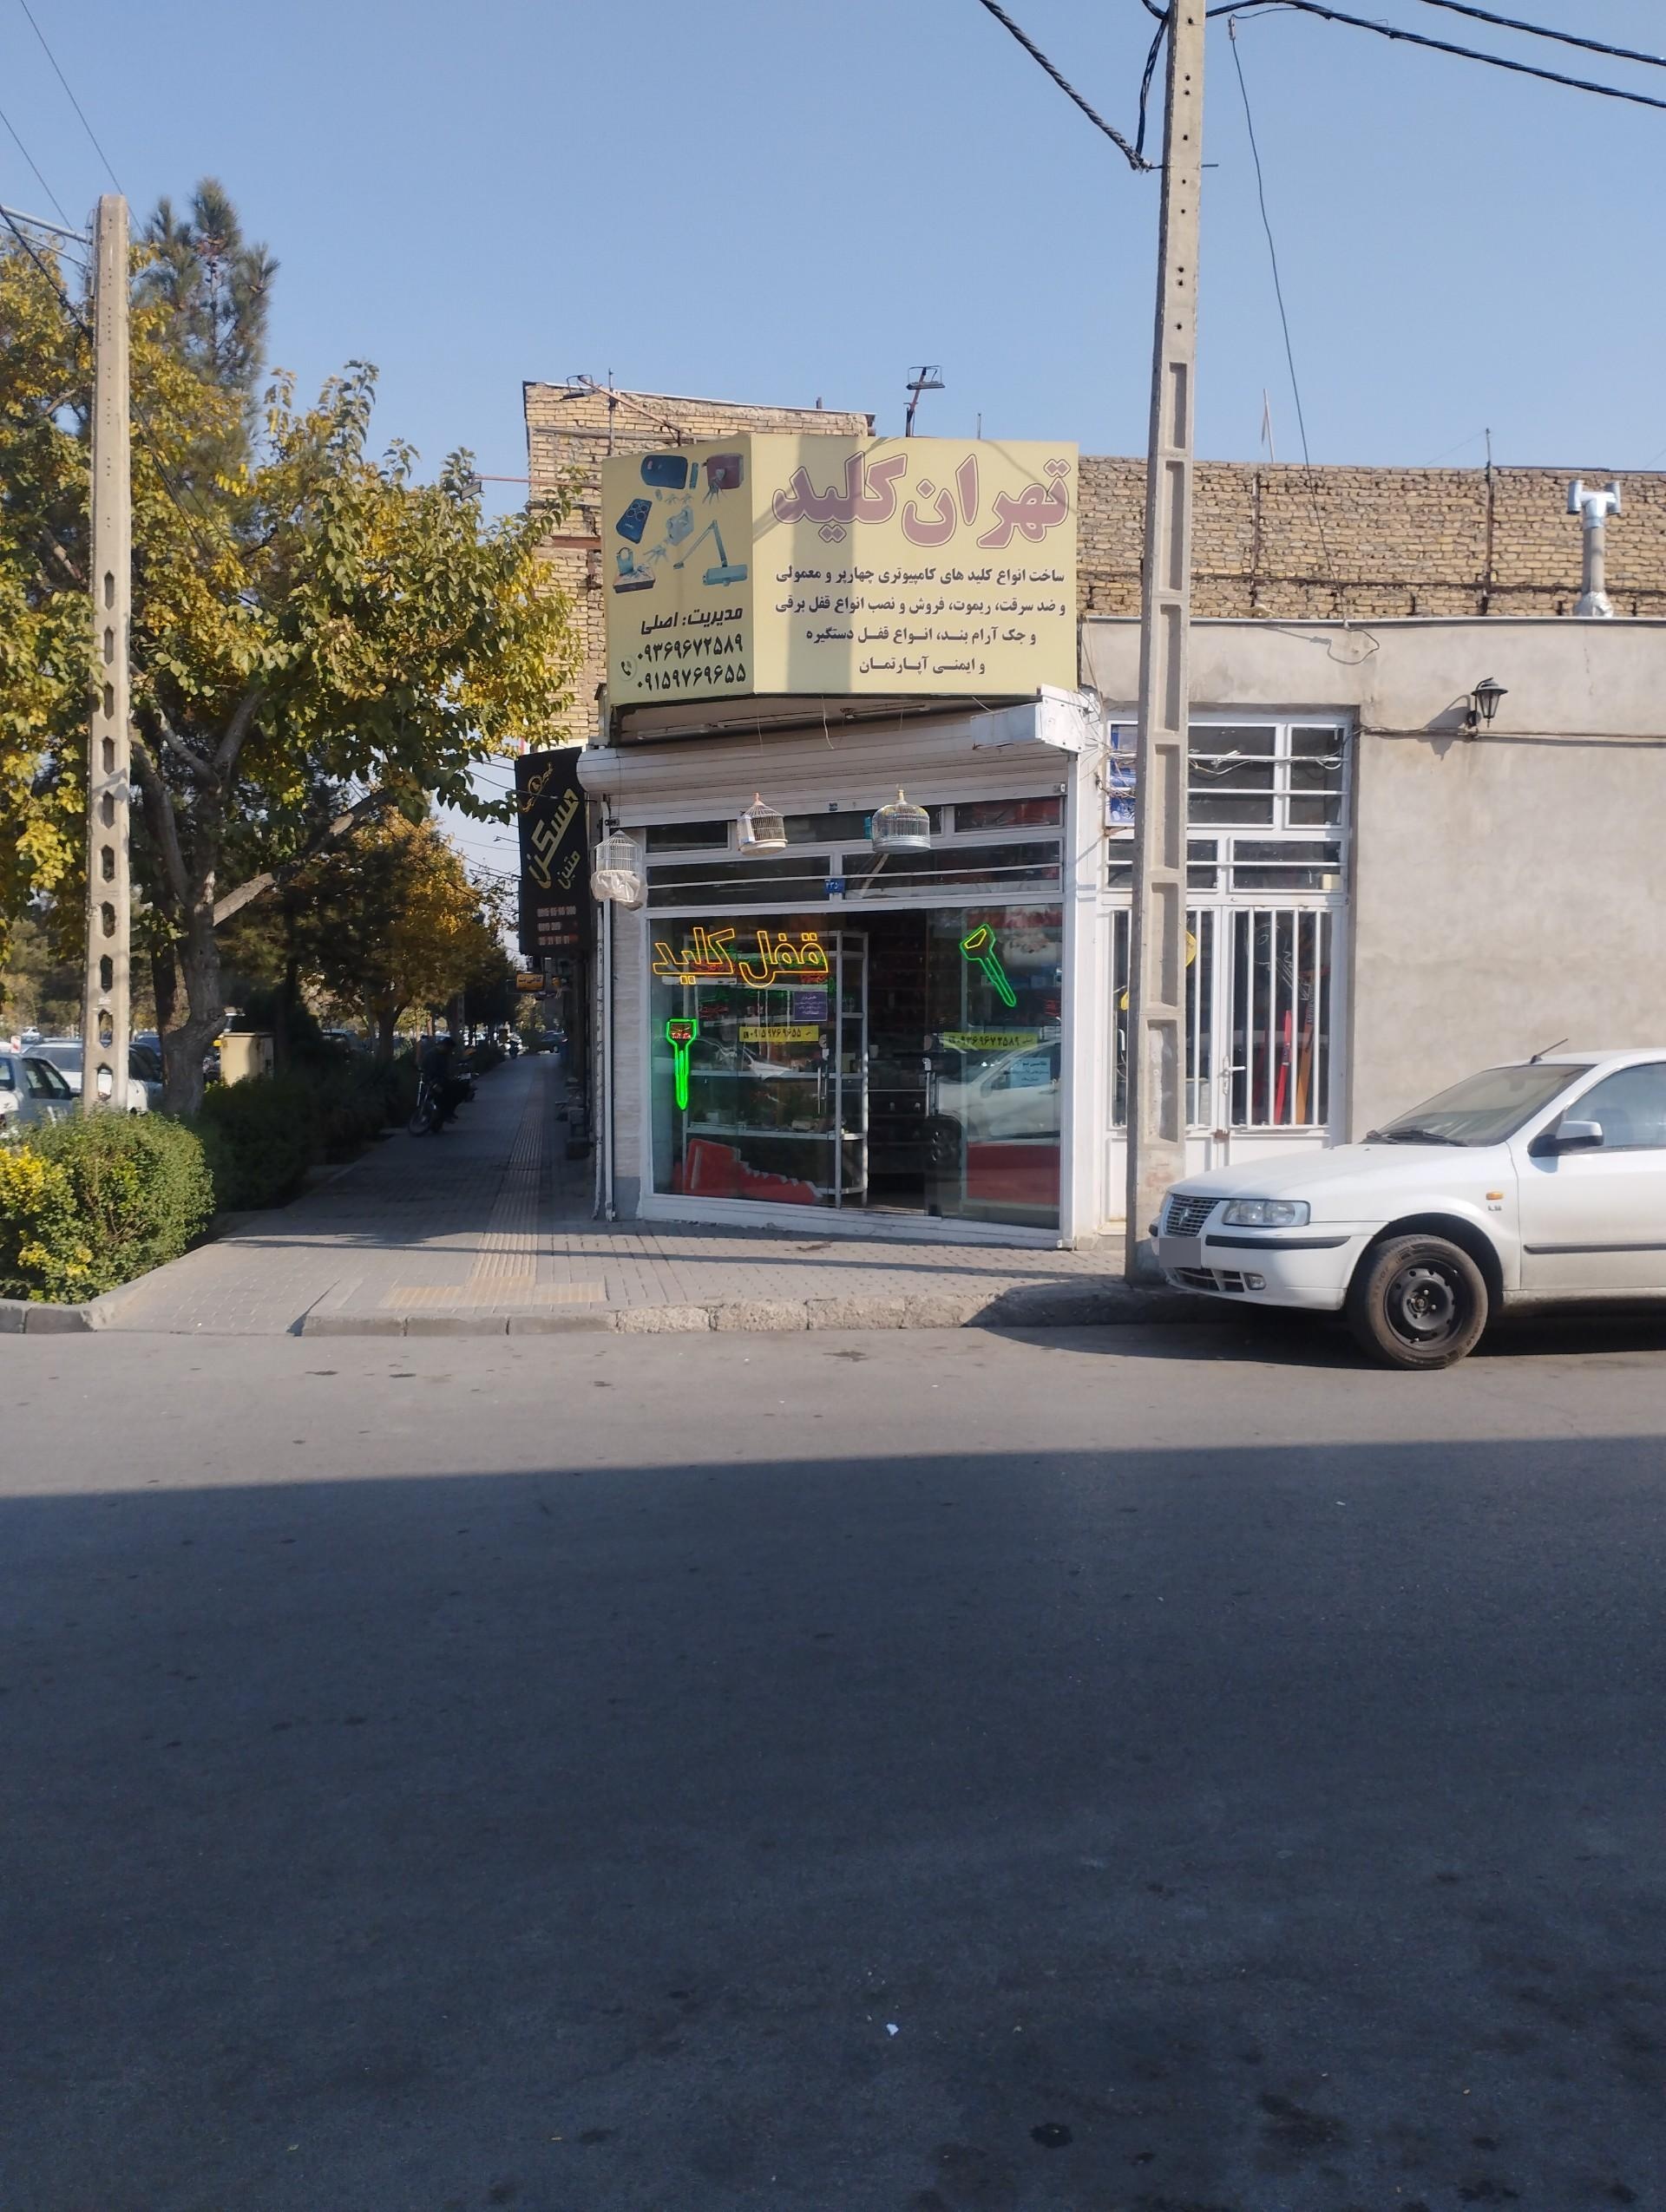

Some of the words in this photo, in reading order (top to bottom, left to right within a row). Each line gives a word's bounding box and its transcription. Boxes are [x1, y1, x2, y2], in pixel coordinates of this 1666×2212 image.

[771, 450, 908, 543] کلید
[902, 453, 1072, 549] تهران
[776, 565, 822, 583] معمولی
[824, 571, 832, 584] و
[834, 566, 875, 585] چهارپر
[877, 566, 937, 586] کامپیوتری
[940, 567, 965, 586] های
[967, 567, 994, 585] کلید
[995, 568, 1026, 586] انواع
[1028, 568, 1065, 582] ساخت
[775, 594, 806, 613] برقی
[808, 594, 831, 613] قفل
[834, 596, 865, 614] انواع
[867, 596, 895, 614] نصب
[898, 602, 906, 615] و
[908, 596, 945, 615] فروش
[1036, 599, 1056, 612] ضد
[1059, 604, 1066, 617] و
[640, 612, 679, 635] اصلی
[805, 625, 855, 645] دستگیره
[857, 625, 889, 644] قفل
[892, 626, 933, 645] انواع
[971, 625, 1000, 645] آرام
[1001, 628, 1026, 645] جک
[1029, 633, 1037, 645] و
[637, 633, 744, 664] ۰۹۳۶۹۶۷۲۵۸۹
[859, 655, 930, 676] آپارتمان
[932, 657, 975, 675] ایمنی
[978, 663, 986, 675] و
[637, 663, 746, 691] ۰۹۱۵۹۷۶۹۶۵۵
[528, 788, 580, 889] مسکن
[556, 850, 581, 890] متین
[653, 926, 736, 985] کلید
[738, 931, 829, 988] قفل
